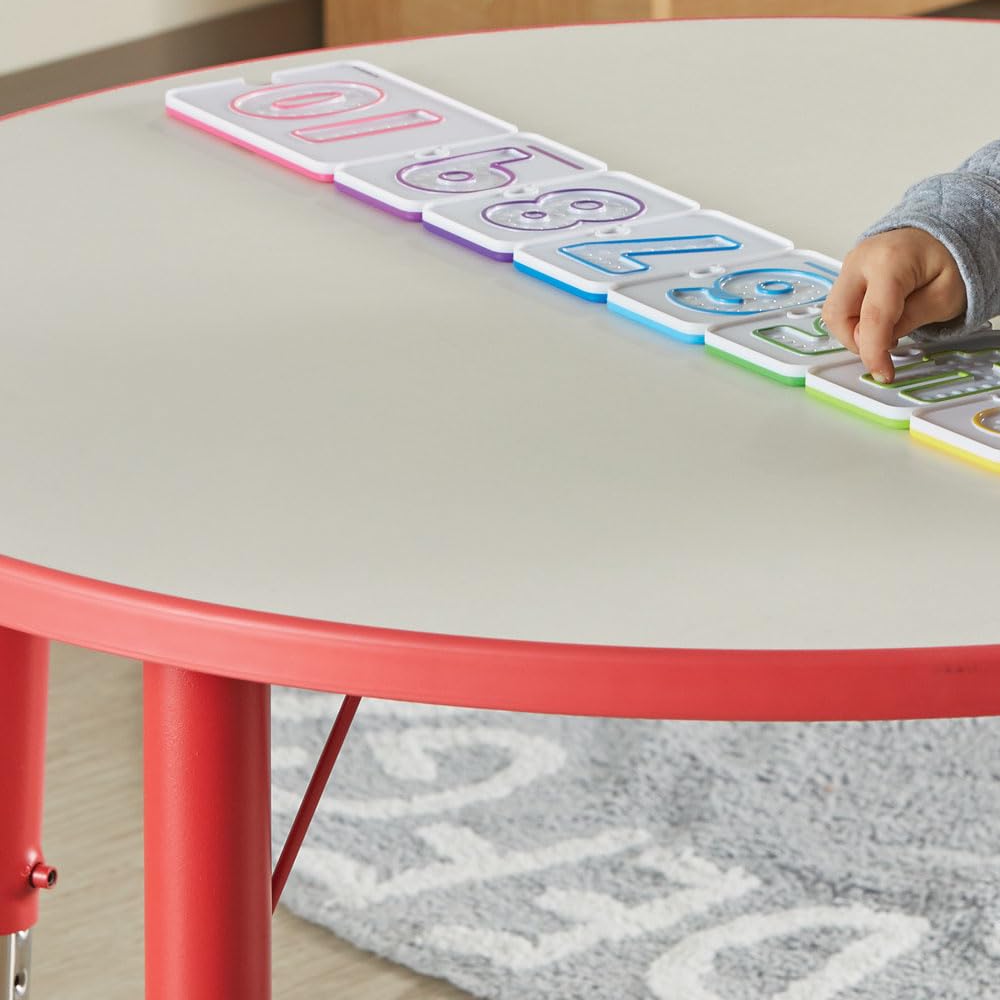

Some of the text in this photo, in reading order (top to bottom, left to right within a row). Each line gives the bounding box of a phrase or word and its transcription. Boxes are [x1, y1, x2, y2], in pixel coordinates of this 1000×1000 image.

[229, 80, 444, 143] 10
[396, 147, 533, 193] 9
[481, 187, 647, 231] 8
[558, 234, 743, 275] 7
[667, 268, 834, 315] 6
